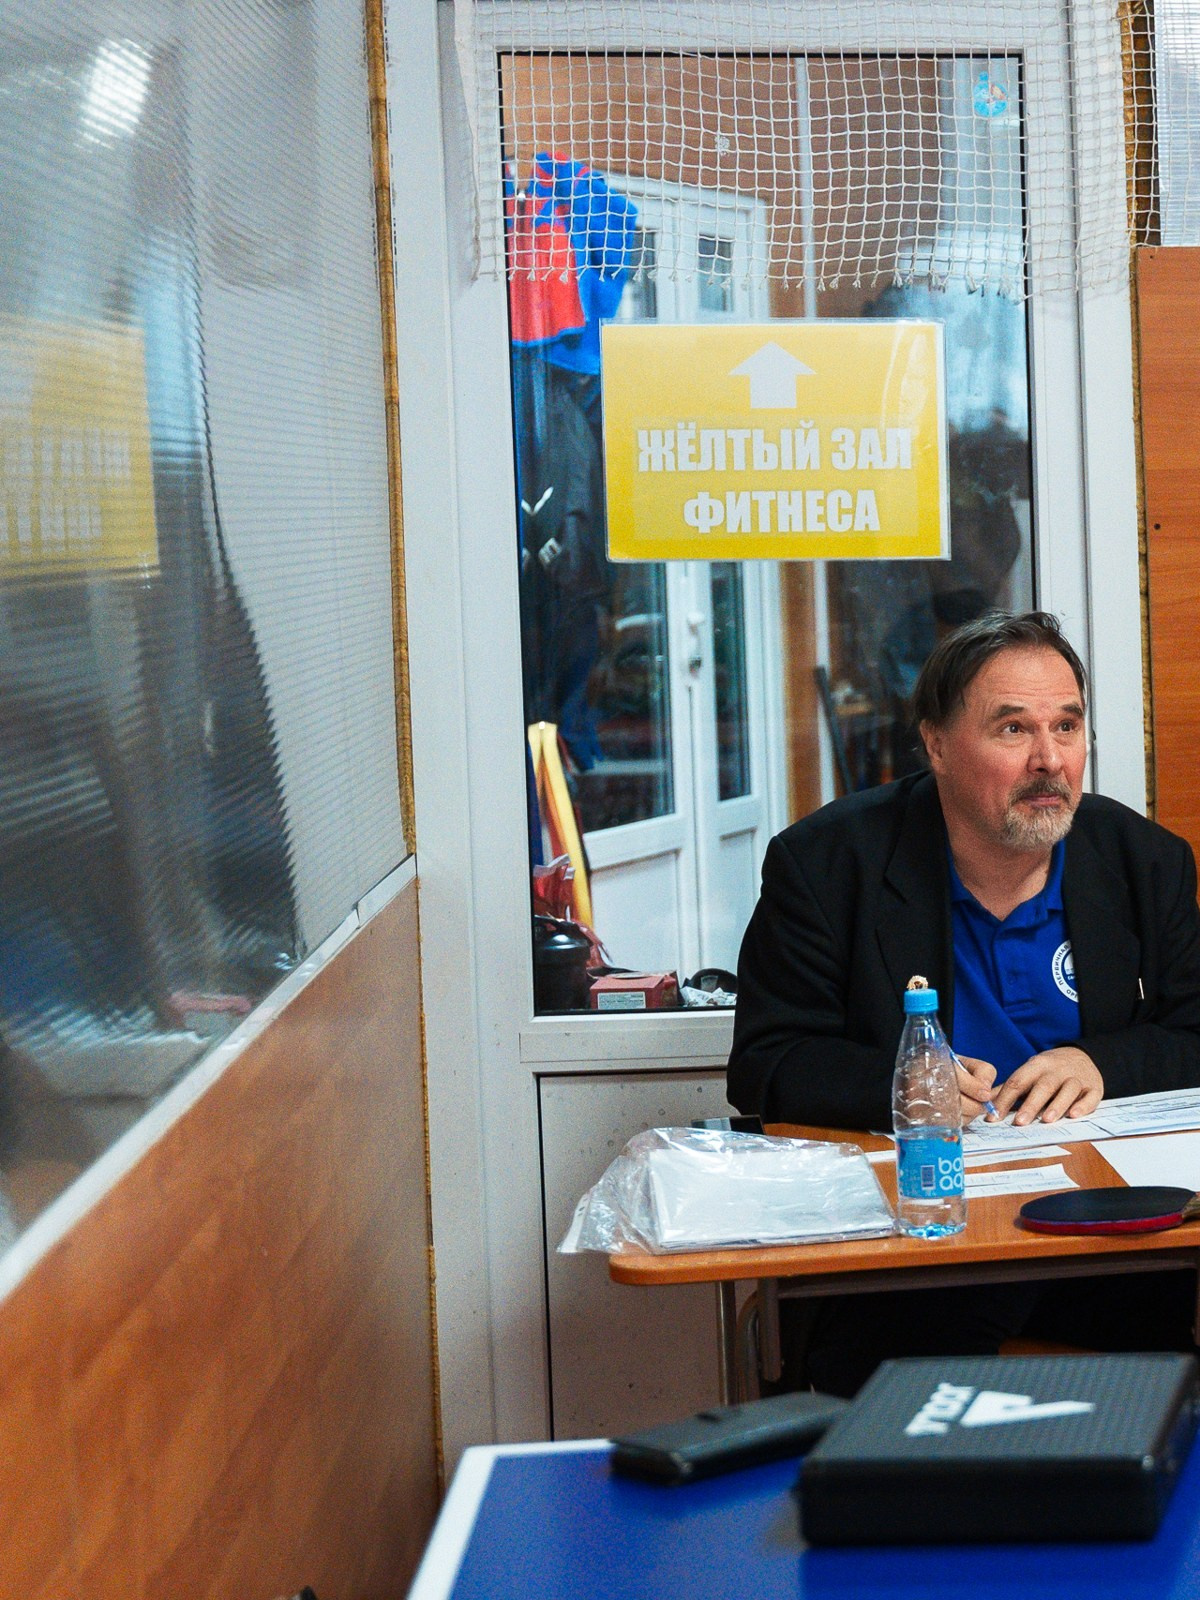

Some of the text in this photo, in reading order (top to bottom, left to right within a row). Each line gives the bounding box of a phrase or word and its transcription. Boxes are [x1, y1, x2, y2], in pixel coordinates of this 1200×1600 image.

[637, 419, 912, 472] ЖЁЛТЫЙ ЗАЛ
[683, 488, 881, 534] ФИТНЕСА
